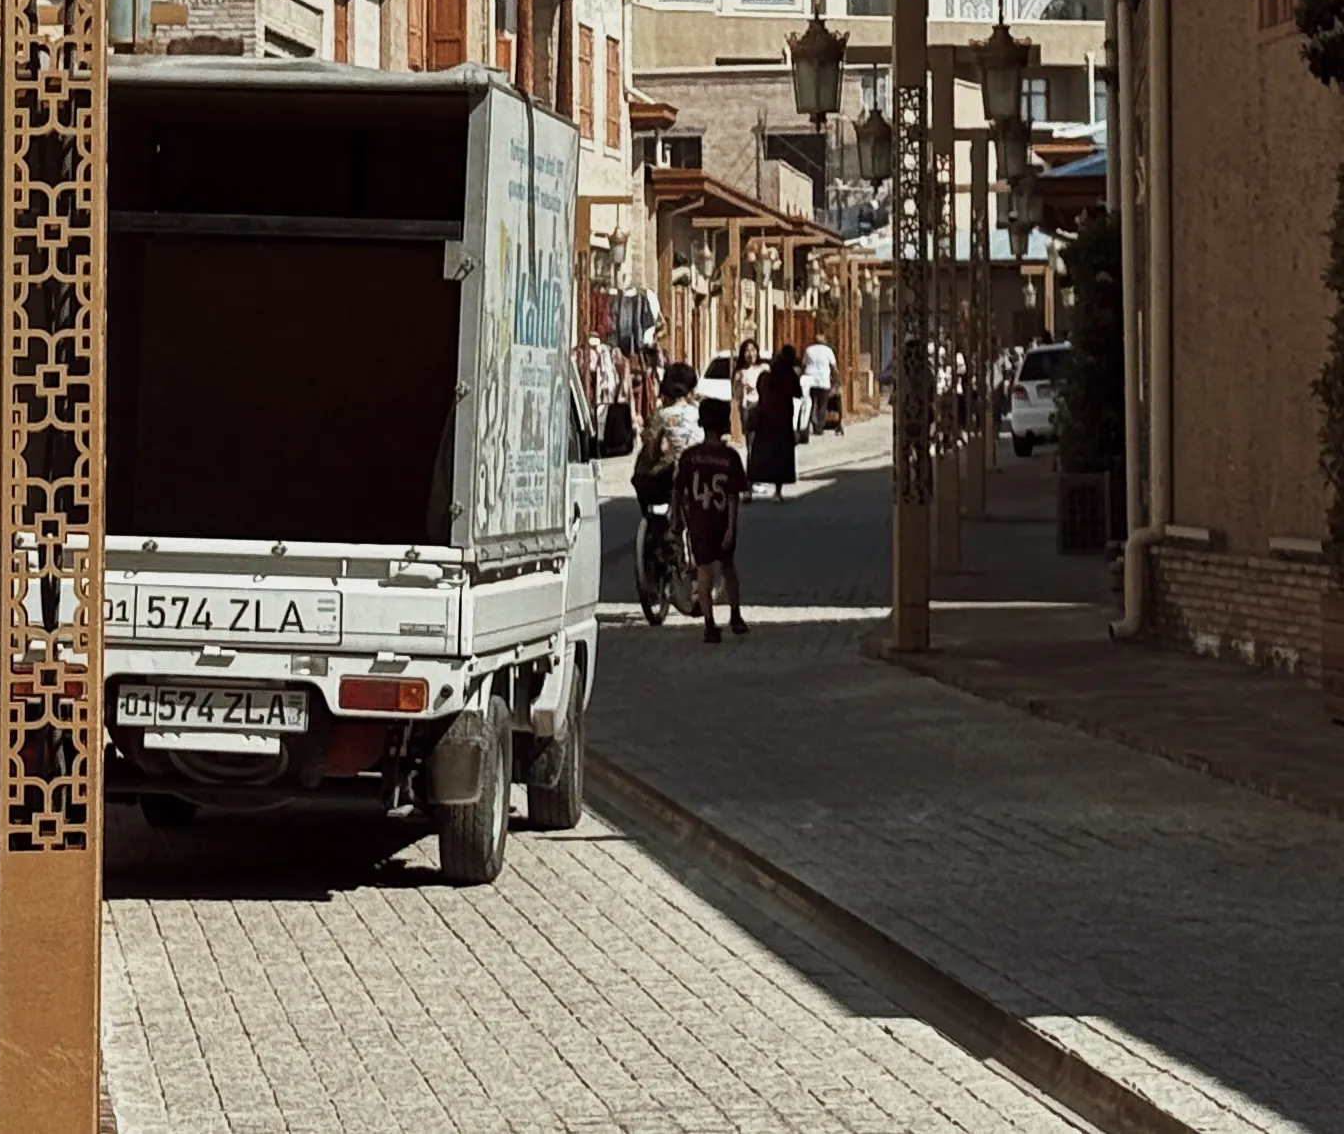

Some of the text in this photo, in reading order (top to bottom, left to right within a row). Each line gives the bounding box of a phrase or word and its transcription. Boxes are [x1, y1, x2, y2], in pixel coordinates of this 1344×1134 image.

[692, 470, 728, 512] 45
[147, 595, 213, 631] 574
[229, 598, 306, 633] ZLA
[125, 691, 152, 717] 01
[158, 689, 215, 723] 574
[222, 691, 287, 726] ZLA
